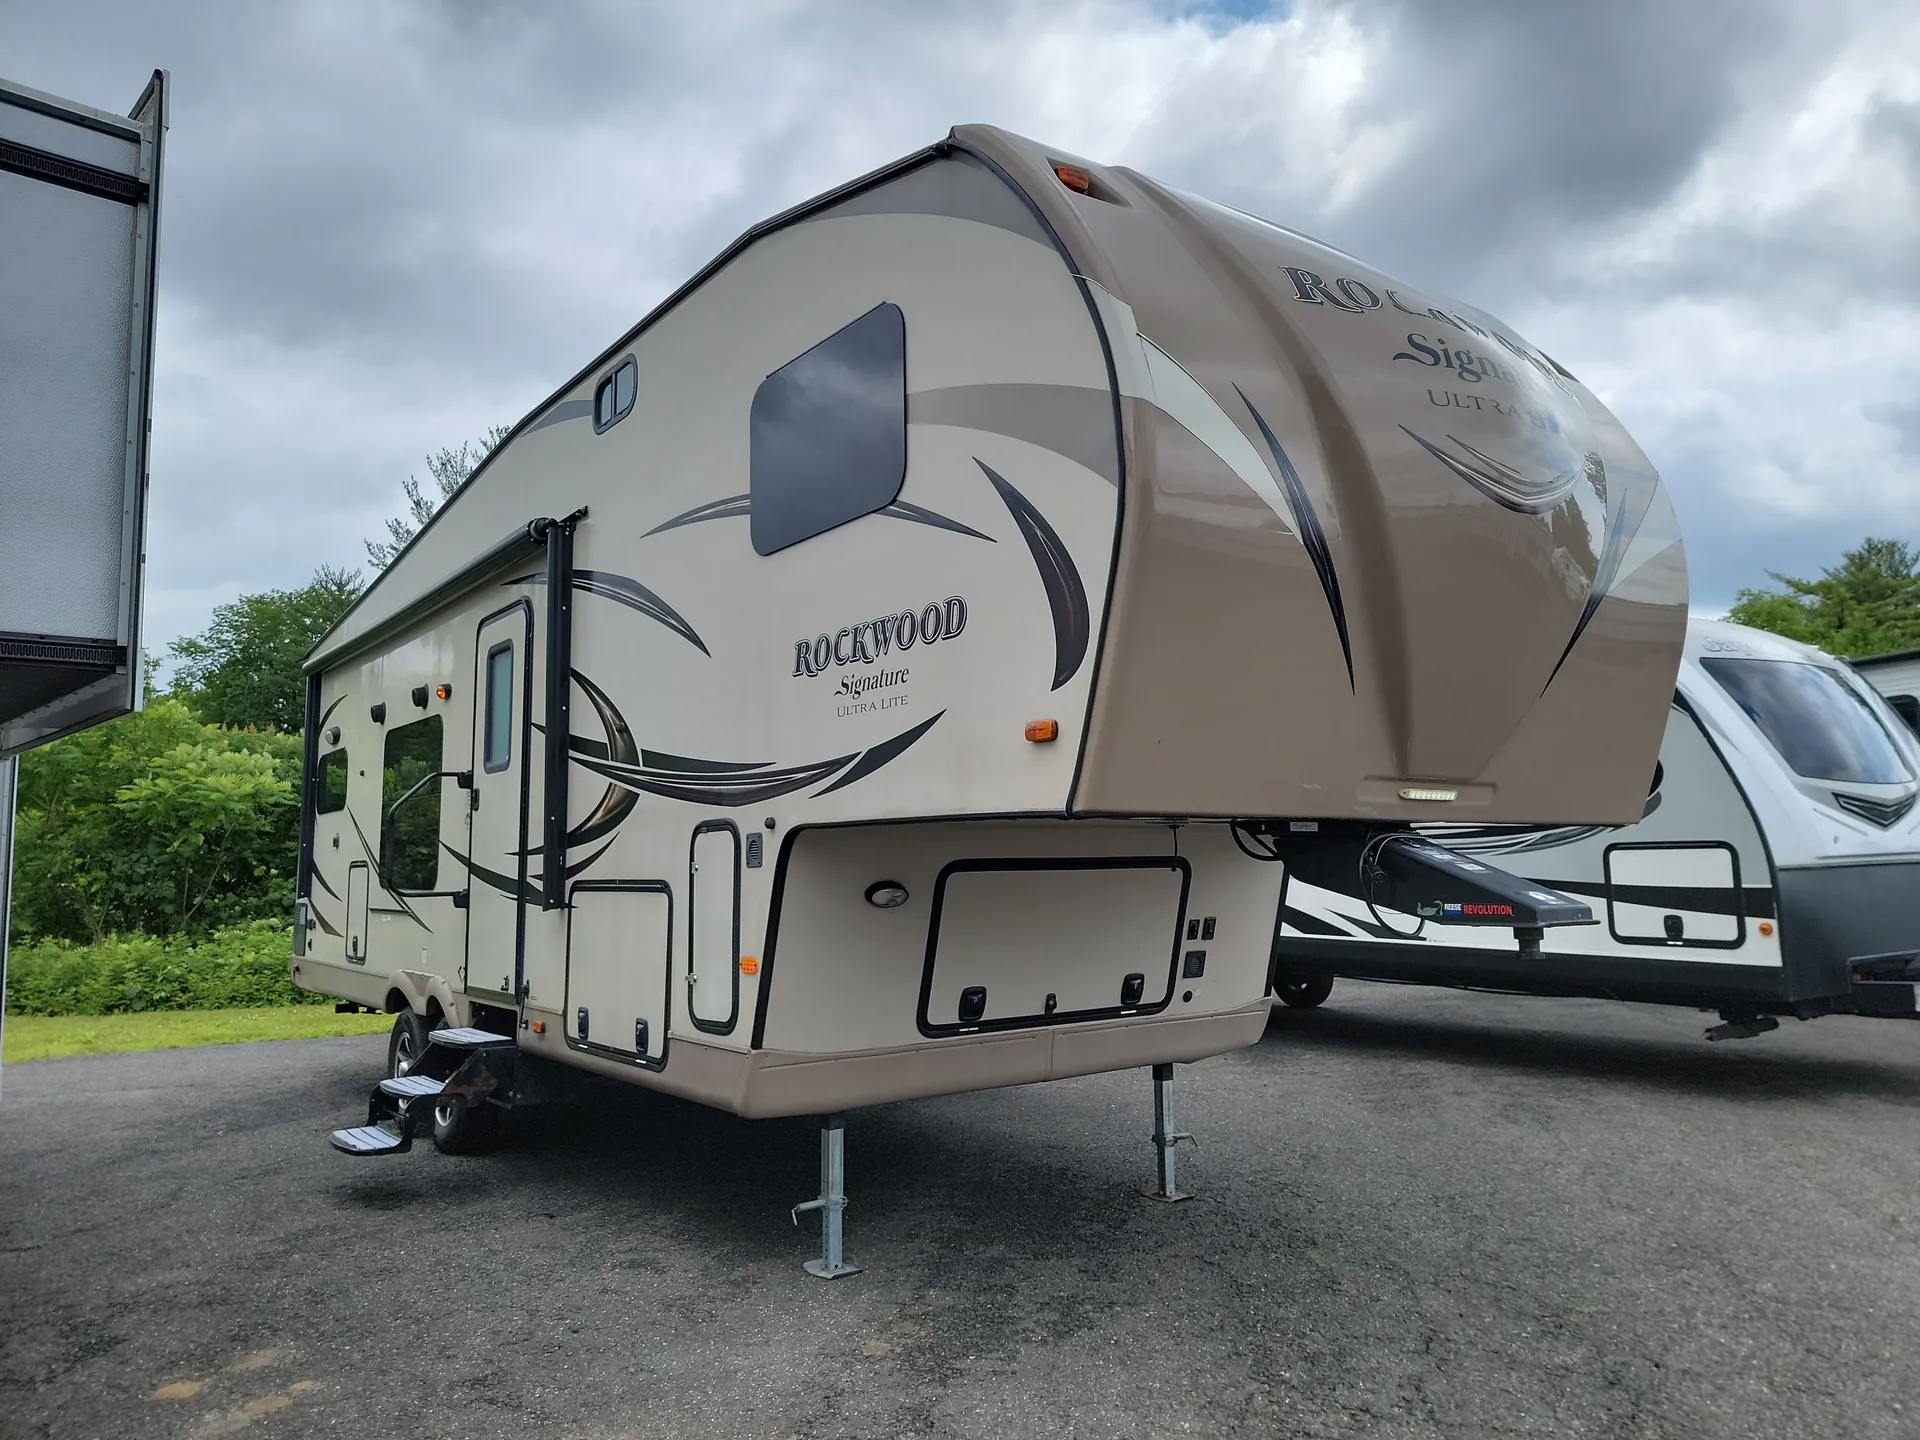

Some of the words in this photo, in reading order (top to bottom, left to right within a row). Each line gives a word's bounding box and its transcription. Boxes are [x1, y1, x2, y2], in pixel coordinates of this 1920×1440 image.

[1393, 333, 1530, 386] Signa
[1427, 389, 1522, 420] ULTRA
[792, 595, 968, 677] ROCKWOOD
[834, 667, 910, 700] Signature
[837, 702, 877, 718] ULTRA
[881, 695, 908, 710] LITE
[1444, 903, 1462, 911] REESE
[1463, 904, 1513, 915] REVOLUTION
